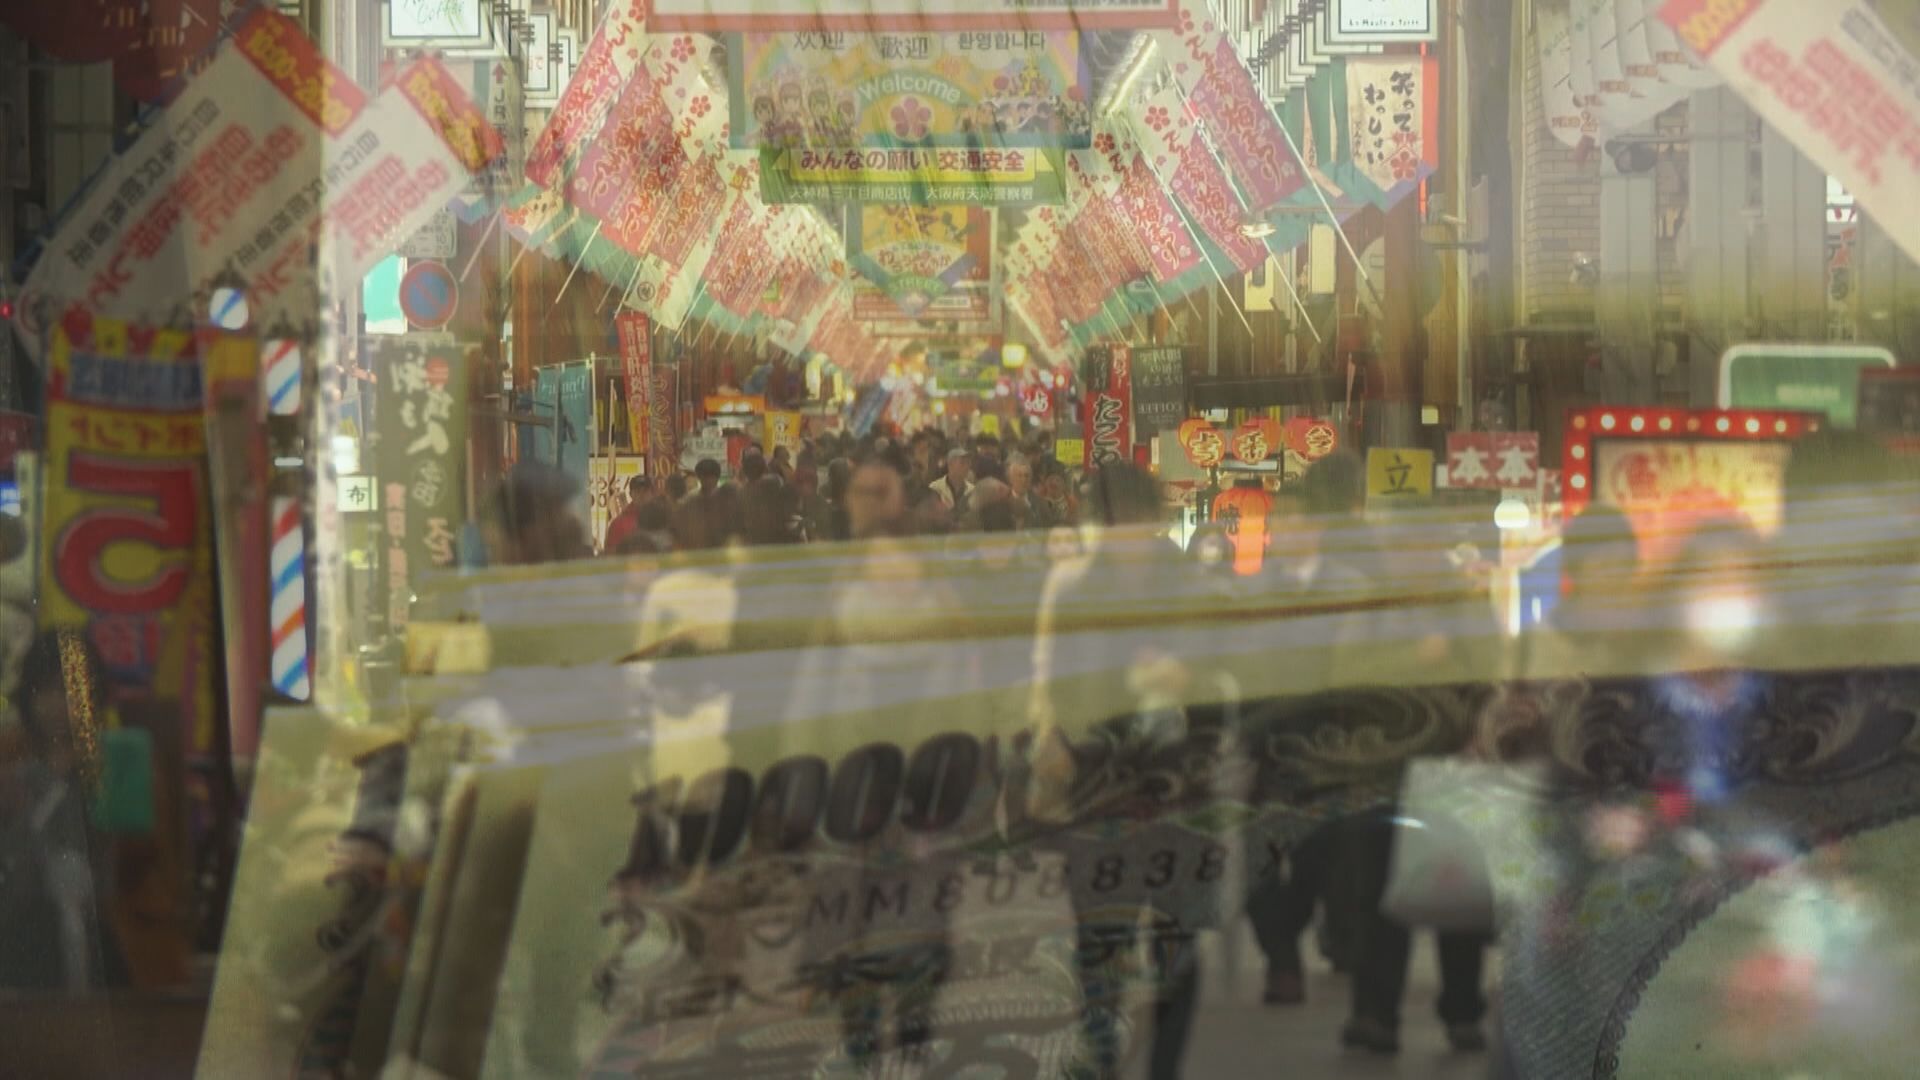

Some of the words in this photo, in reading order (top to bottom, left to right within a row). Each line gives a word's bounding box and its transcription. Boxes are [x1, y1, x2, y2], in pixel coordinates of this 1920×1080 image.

[793, 31, 845, 52] 欢迎
[957, 31, 1047, 52] 환영합니다
[858, 70, 962, 104] Welcome
[1390, 71, 1416, 132] 笑って
[1363, 83, 1386, 165] わっしょい
[800, 150, 929, 171] みんなの願い
[938, 150, 1025, 172] 交通安全
[1384, 455, 1419, 495] 立
[345, 484, 367, 506] 布
